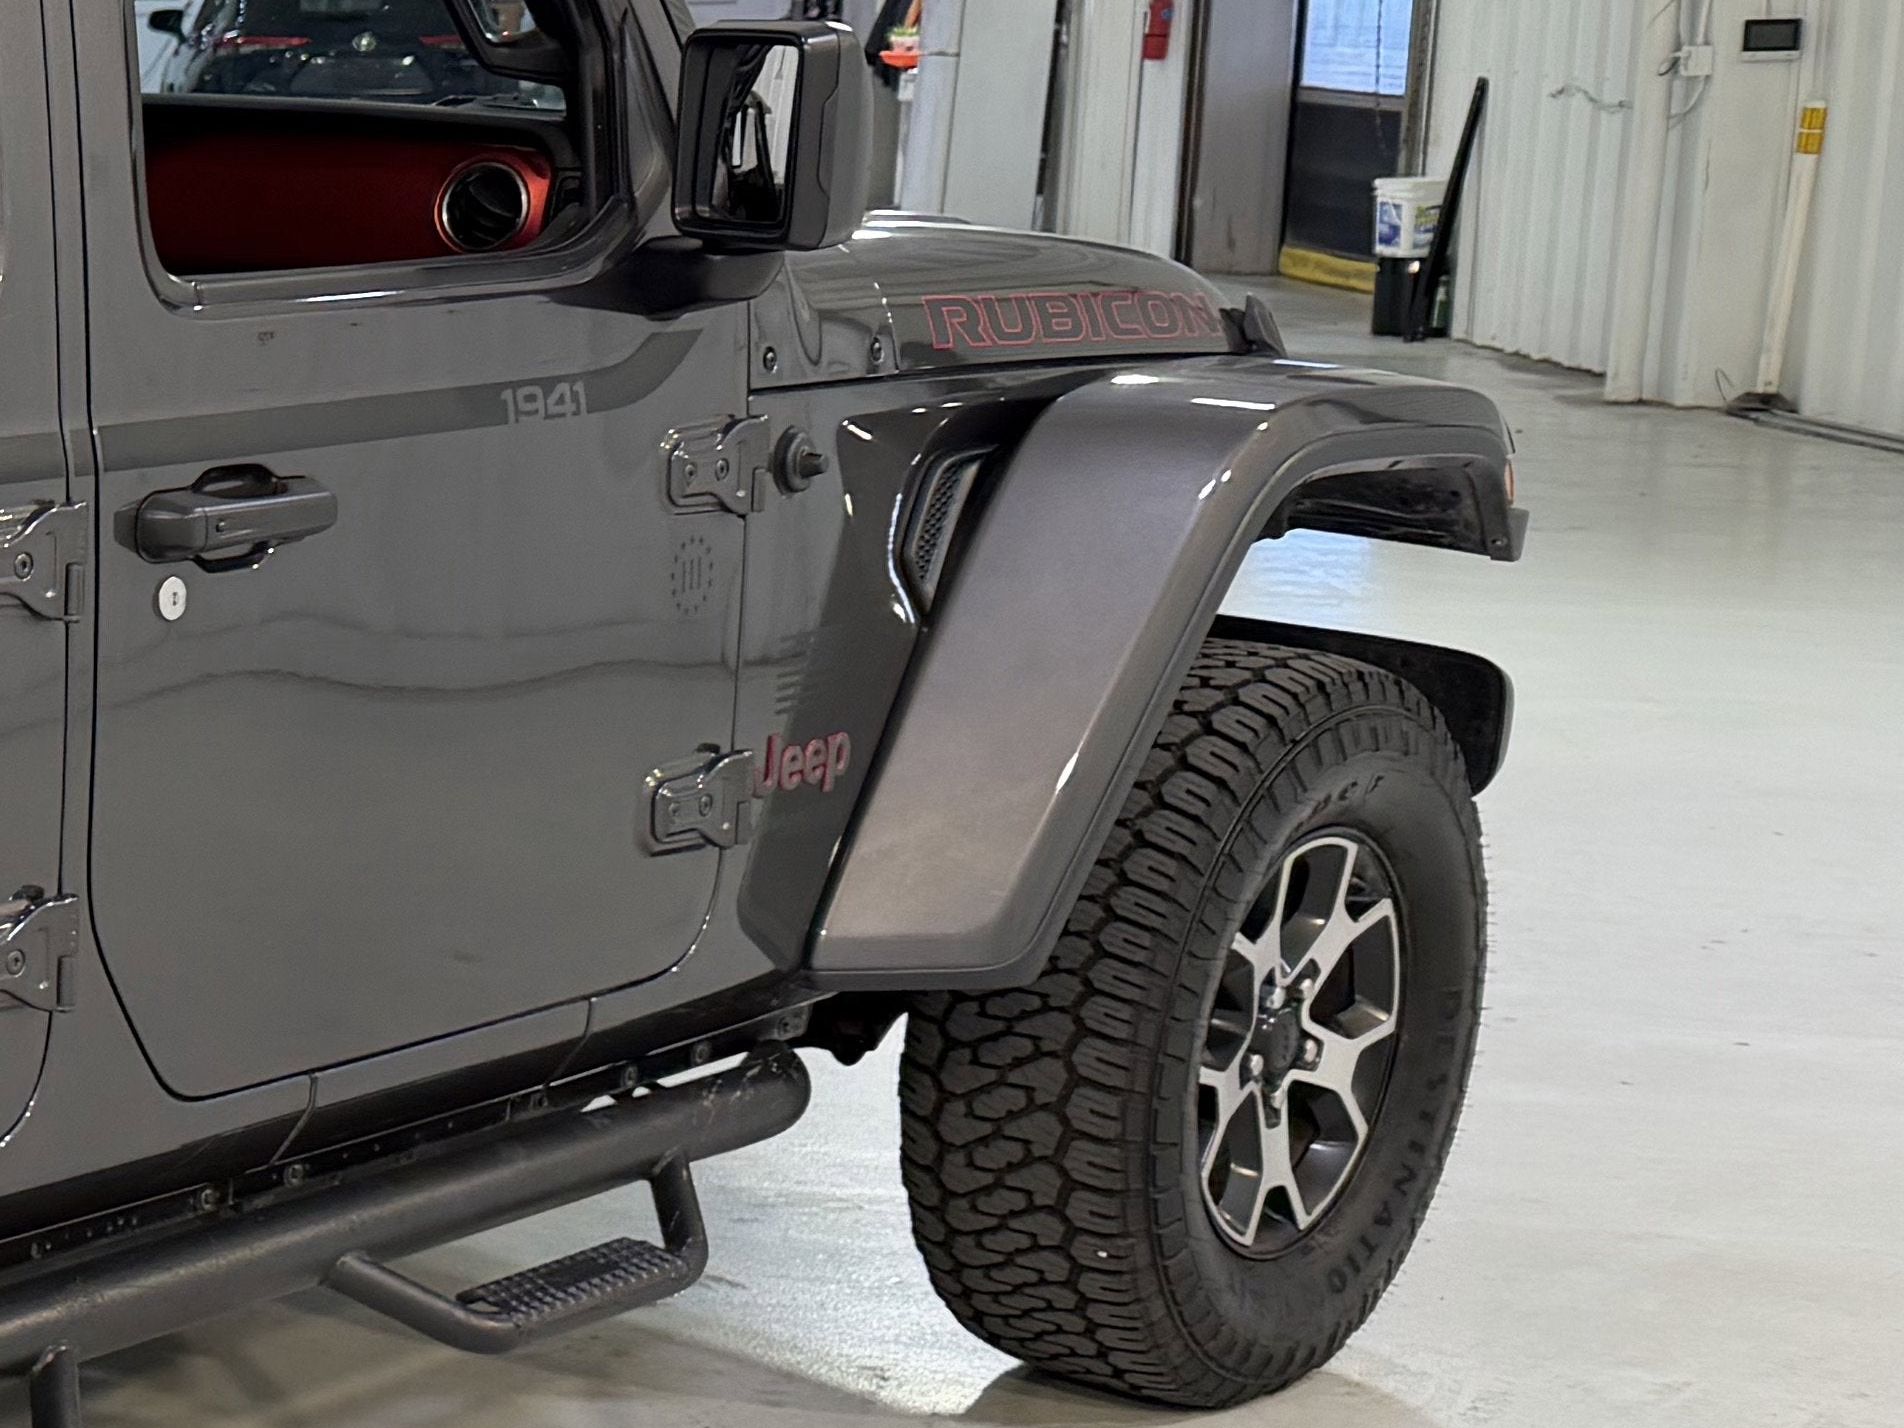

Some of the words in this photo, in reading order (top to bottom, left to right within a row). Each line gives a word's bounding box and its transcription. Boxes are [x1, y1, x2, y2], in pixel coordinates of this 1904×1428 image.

[921, 290, 1225, 350] RUBICON
[500, 379, 588, 424] 1941
[752, 731, 851, 799] Jeep
